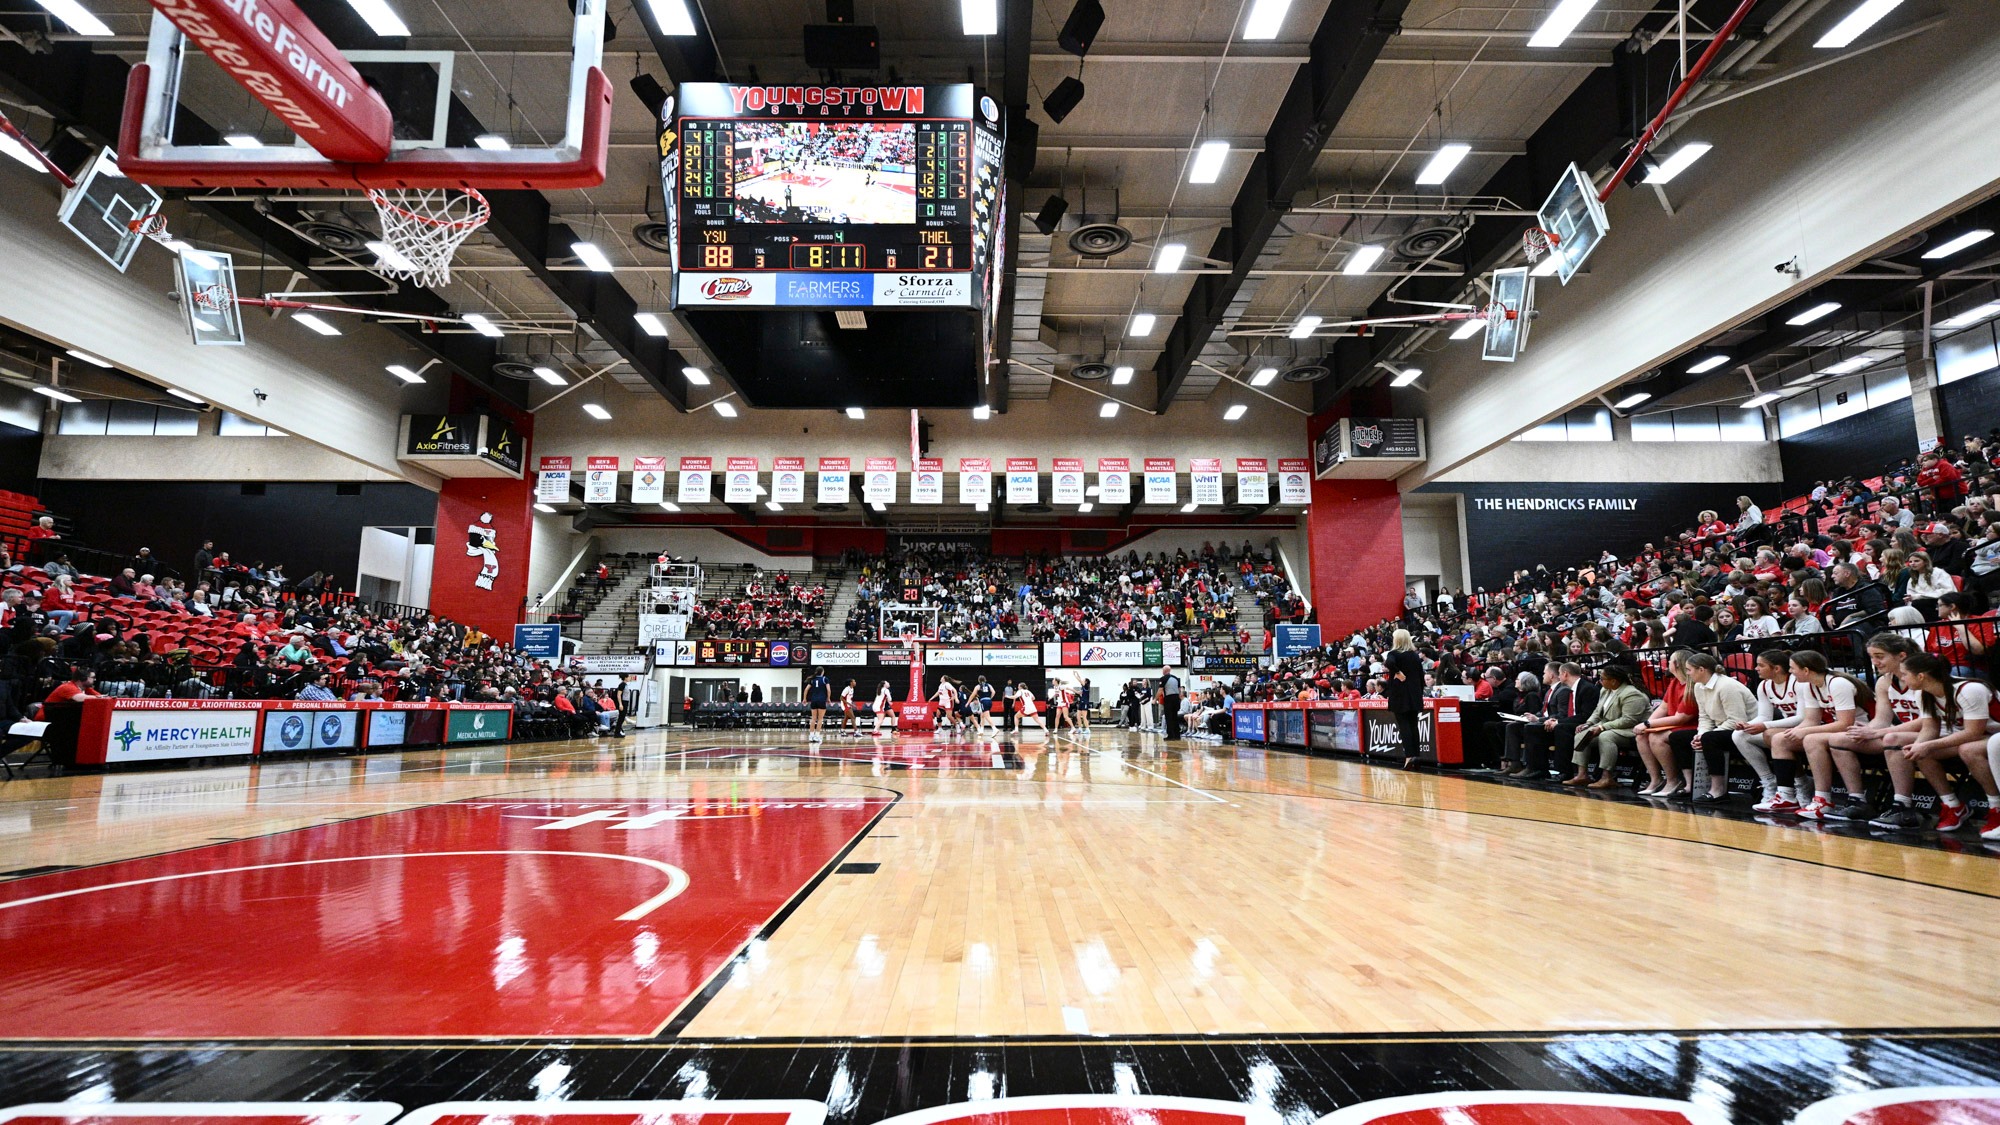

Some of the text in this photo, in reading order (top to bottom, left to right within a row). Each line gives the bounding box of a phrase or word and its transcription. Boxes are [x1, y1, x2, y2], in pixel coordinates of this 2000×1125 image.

[730, 86, 924, 114] YOUNGSTOWN
[771, 104, 874, 115] STATE
[694, 132, 732, 143] 4 2 7
[939, 133, 945, 144] 3
[958, 133, 965, 144] 2
[976, 126, 1001, 147] BUFFALO
[686, 145, 732, 156] 20 8
[927, 146, 966, 157] 2 0
[976, 134, 1001, 158] WILD
[975, 146, 999, 168] WINGS
[686, 159, 732, 169] 21 9
[927, 161, 965, 170] 4 4 4
[686, 172, 732, 183] 24 2 5
[923, 174, 965, 184] 12 3 7
[686, 186, 732, 197] 44 0 2
[919, 186, 965, 198] 42 3 5
[927, 205, 933, 216] 0
[704, 231, 727, 243] YSU
[835, 232, 842, 243] 4
[920, 231, 952, 244] THIEL
[705, 246, 732, 267] 88
[756, 256, 764, 267] 3
[810, 246, 859, 267] 8:11
[925, 246, 952, 268] 21
[889, 257, 894, 268] 0
[899, 275, 953, 286] Sforza
[702, 278, 752, 299] Cane's
[789, 281, 860, 293] FARMERS
[900, 287, 962, 296] Carmella's
[1351, 430, 1384, 441] BUCKEYE
[490, 448, 518, 467] AxioFitness
[1475, 498, 1637, 510] THE HENDRICKS FAMILY
[485, 564, 497, 573] Y
[904, 589, 918, 600] 20
[644, 624, 681, 633] CIRELLI
[724, 642, 749, 652] 8:11
[702, 648, 768, 658] 88 21
[146, 727, 251, 741] MERCYHEALTH
